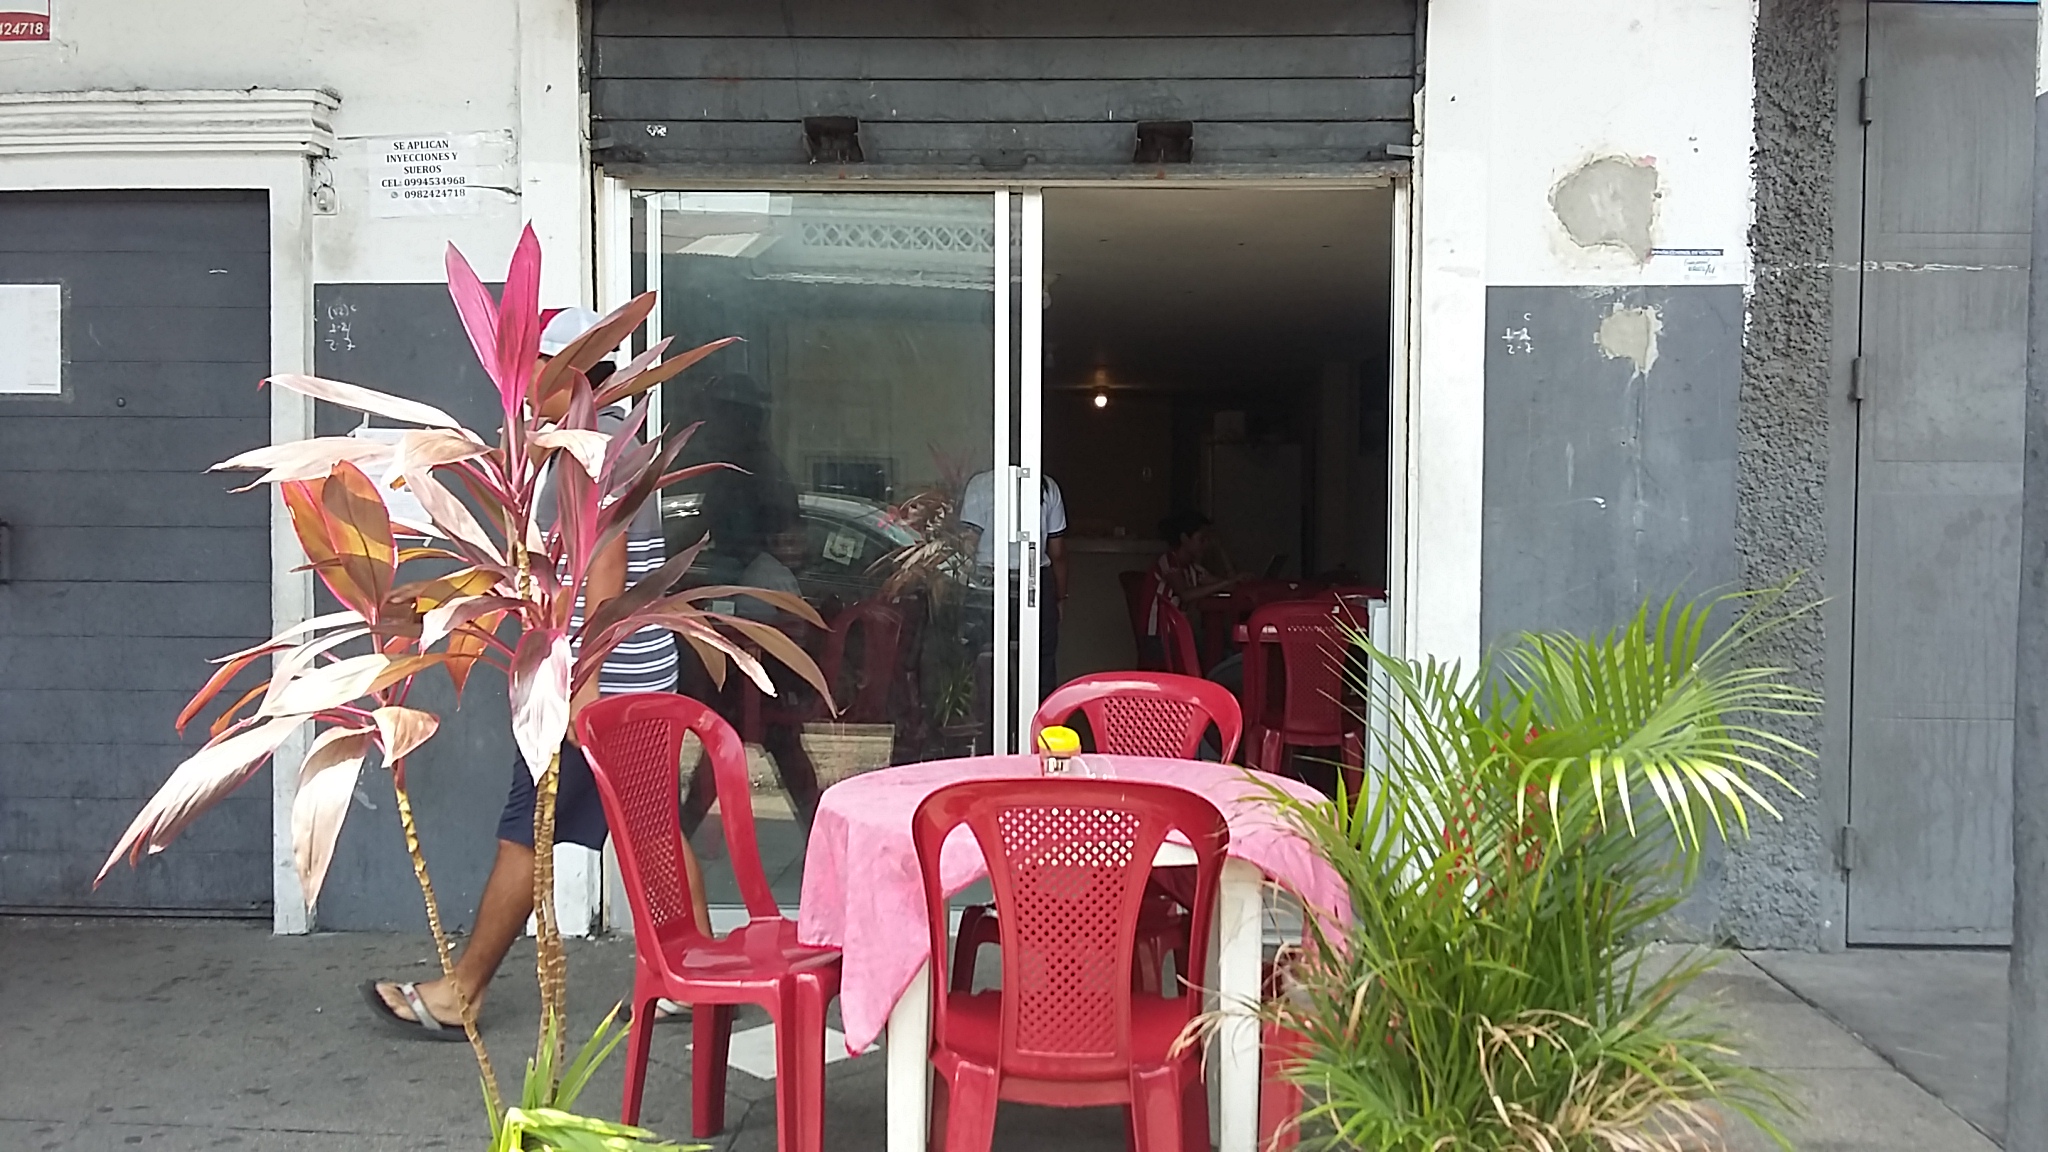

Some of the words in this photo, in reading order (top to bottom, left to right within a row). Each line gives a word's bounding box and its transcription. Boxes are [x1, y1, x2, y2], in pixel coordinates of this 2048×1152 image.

[393, 141, 405, 150] SE
[407, 140, 449, 150] APLICAN
[386, 152, 450, 163] INYECCIONES
[451, 152, 458, 161] Y
[403, 165, 442, 175] SUEROS
[404, 176, 466, 187] 0994534968
[404, 188, 466, 199] 0982424718
